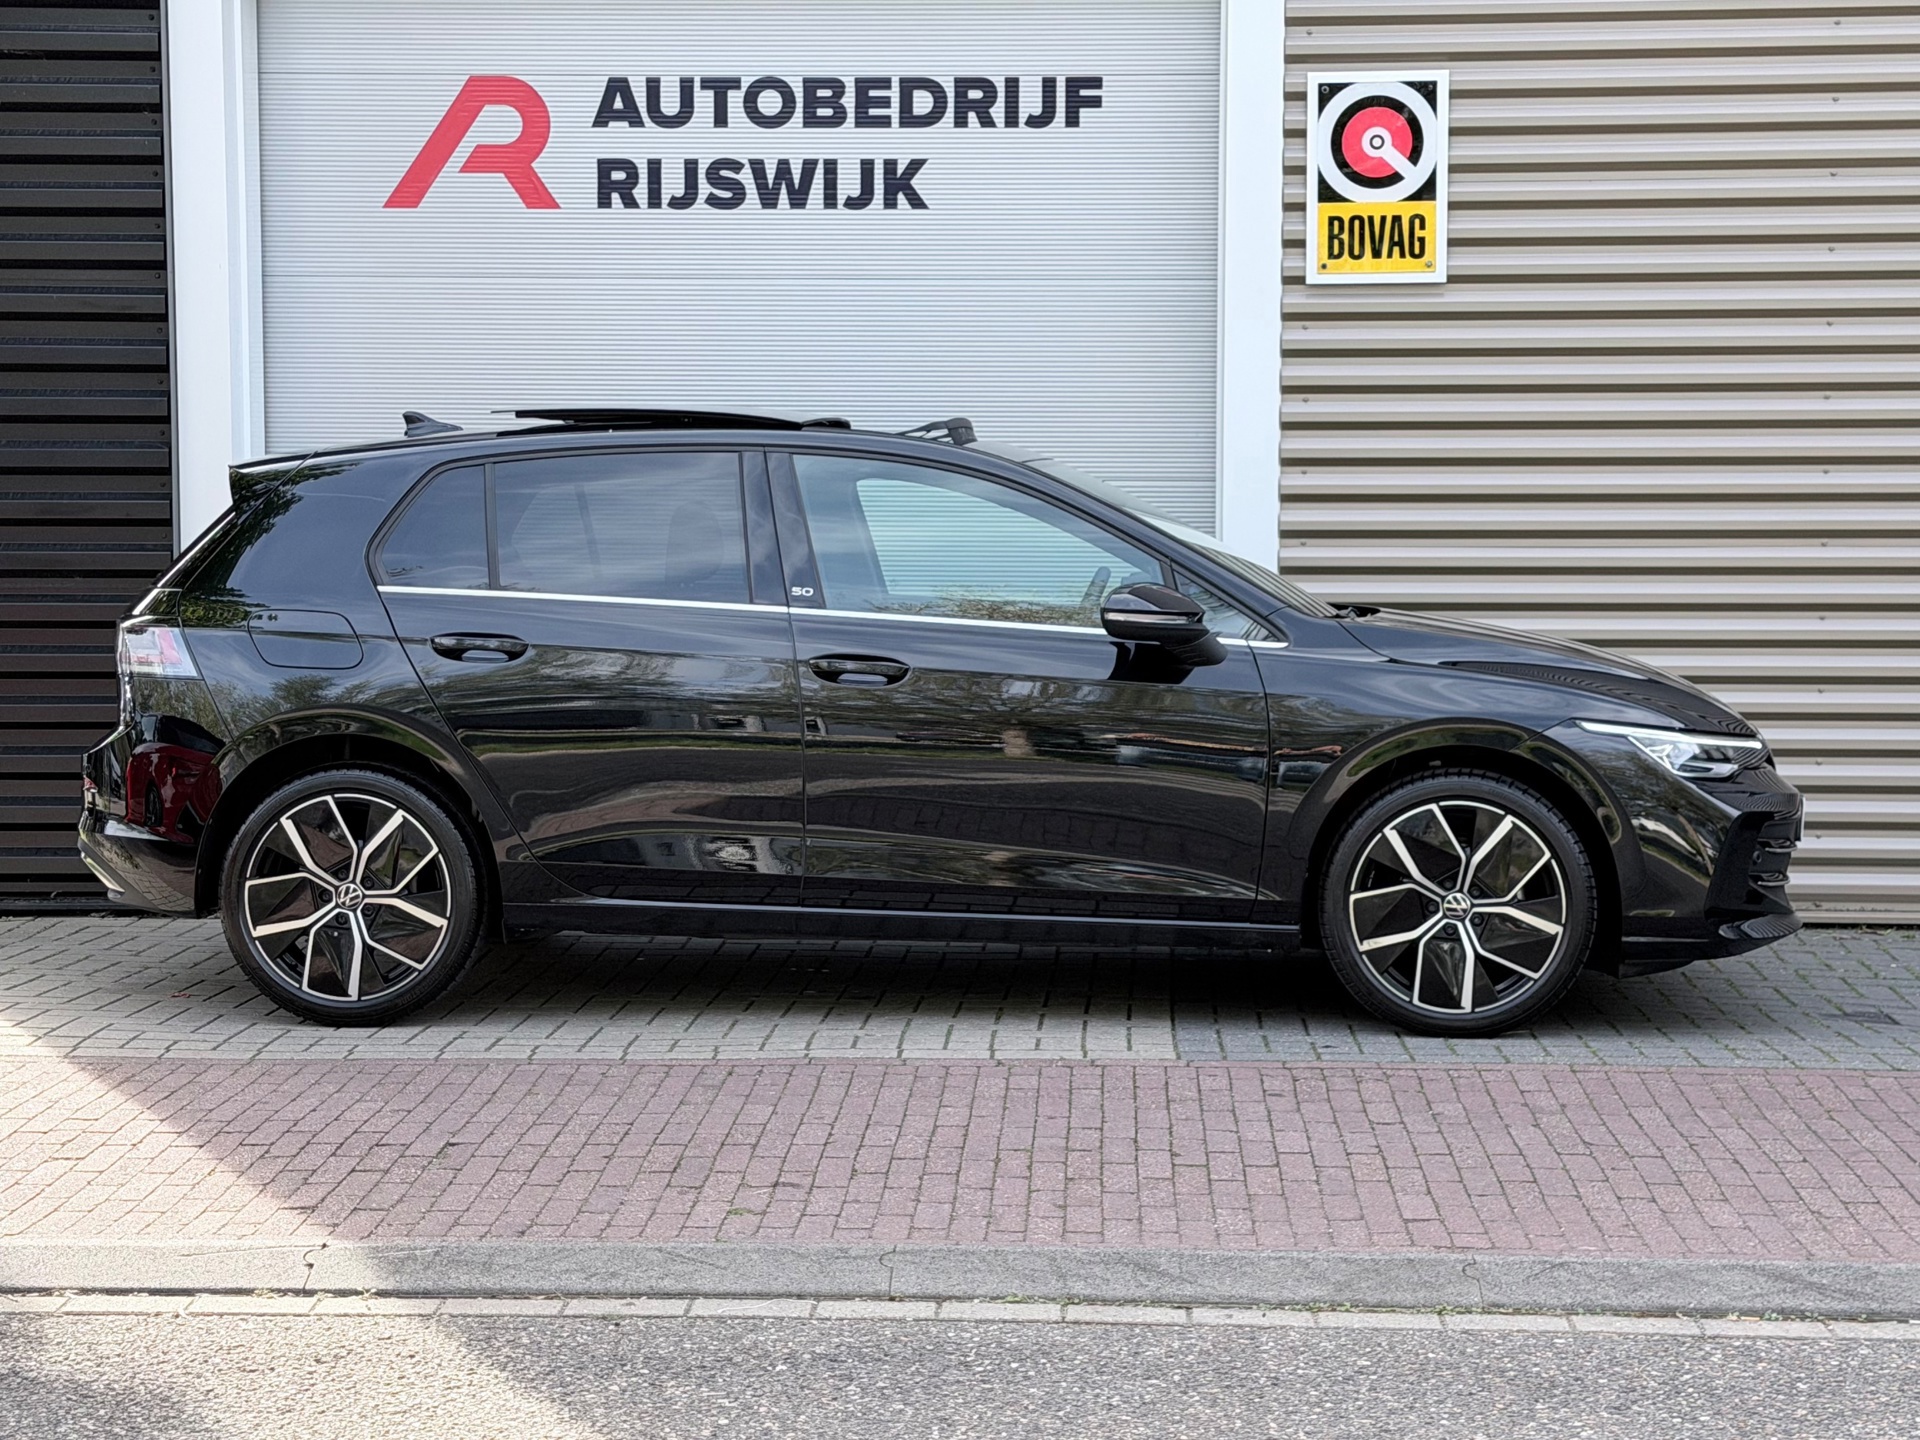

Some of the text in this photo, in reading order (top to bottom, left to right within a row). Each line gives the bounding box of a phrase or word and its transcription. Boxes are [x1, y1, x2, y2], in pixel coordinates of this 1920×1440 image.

[591, 76, 1104, 129] AUTOBEDRIJF
[596, 158, 930, 210] RIJSWIJK
[1327, 213, 1427, 260] BOVAG
[791, 586, 814, 597] 50
